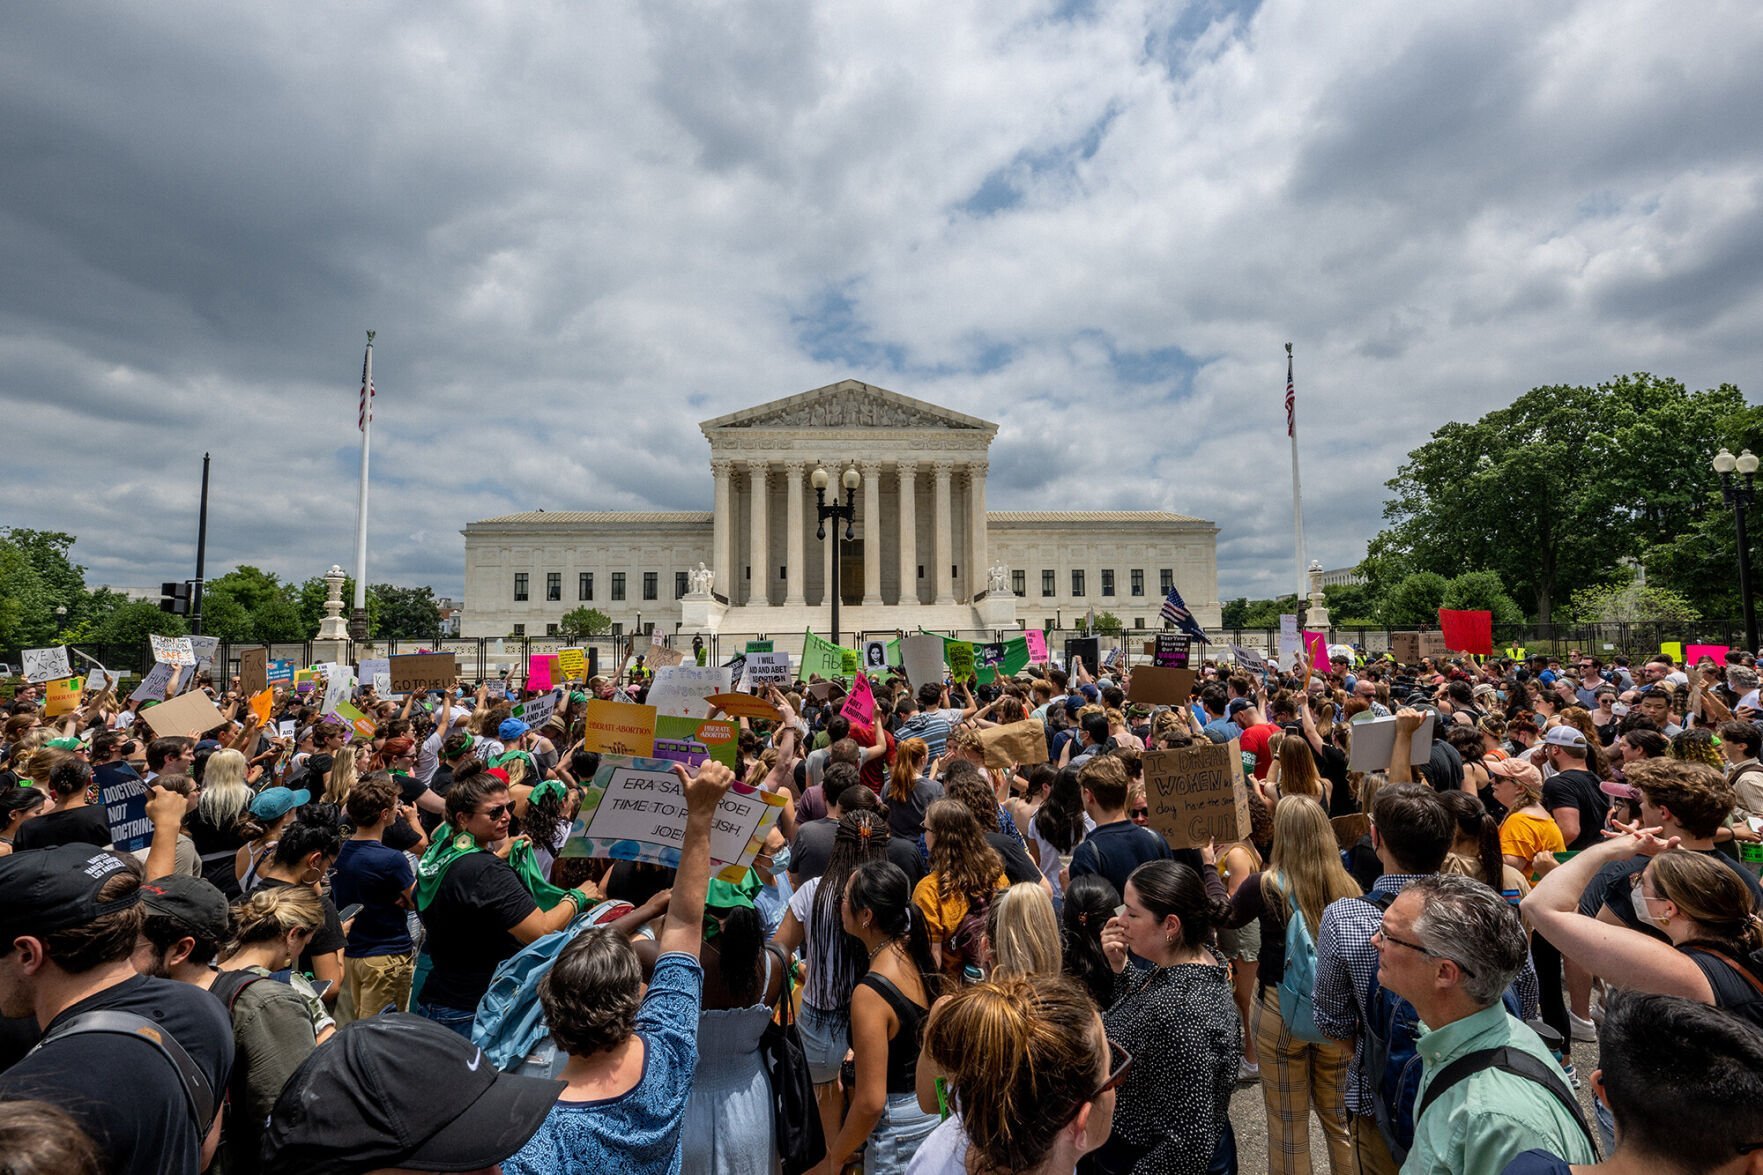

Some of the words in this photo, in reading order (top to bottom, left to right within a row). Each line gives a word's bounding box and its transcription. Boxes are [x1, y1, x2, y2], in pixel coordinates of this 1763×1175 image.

[24, 650, 48, 663] WE
[161, 651, 182, 659] SAFE
[757, 656, 760, 664] I
[761, 656, 775, 665] WILL
[28, 671, 48, 681] GO
[770, 665, 787, 674] ABET
[393, 679, 411, 691] GO
[412, 679, 427, 690] TO
[531, 701, 545, 712] WILL
[847, 698, 863, 710] ABET
[526, 712, 539, 722] AND
[539, 706, 553, 718] ABET
[844, 706, 871, 726] ABORTION
[589, 722, 615, 731] LIBERATE
[616, 726, 651, 735] ABORTION
[704, 724, 731, 732] LIBERATE
[700, 731, 731, 739] ABORTION
[1146, 753, 1167, 776] I
[623, 777, 654, 791] ERA
[1154, 770, 1223, 797] WOMEN
[103, 779, 148, 804] DOCTORS
[107, 803, 128, 823] NOT
[612, 798, 646, 812] TIME
[653, 801, 675, 815] TO
[1156, 801, 1177, 820] day
[1184, 800, 1205, 811] have
[110, 816, 155, 843] DOCTRINE
[651, 824, 686, 842] JOE!
